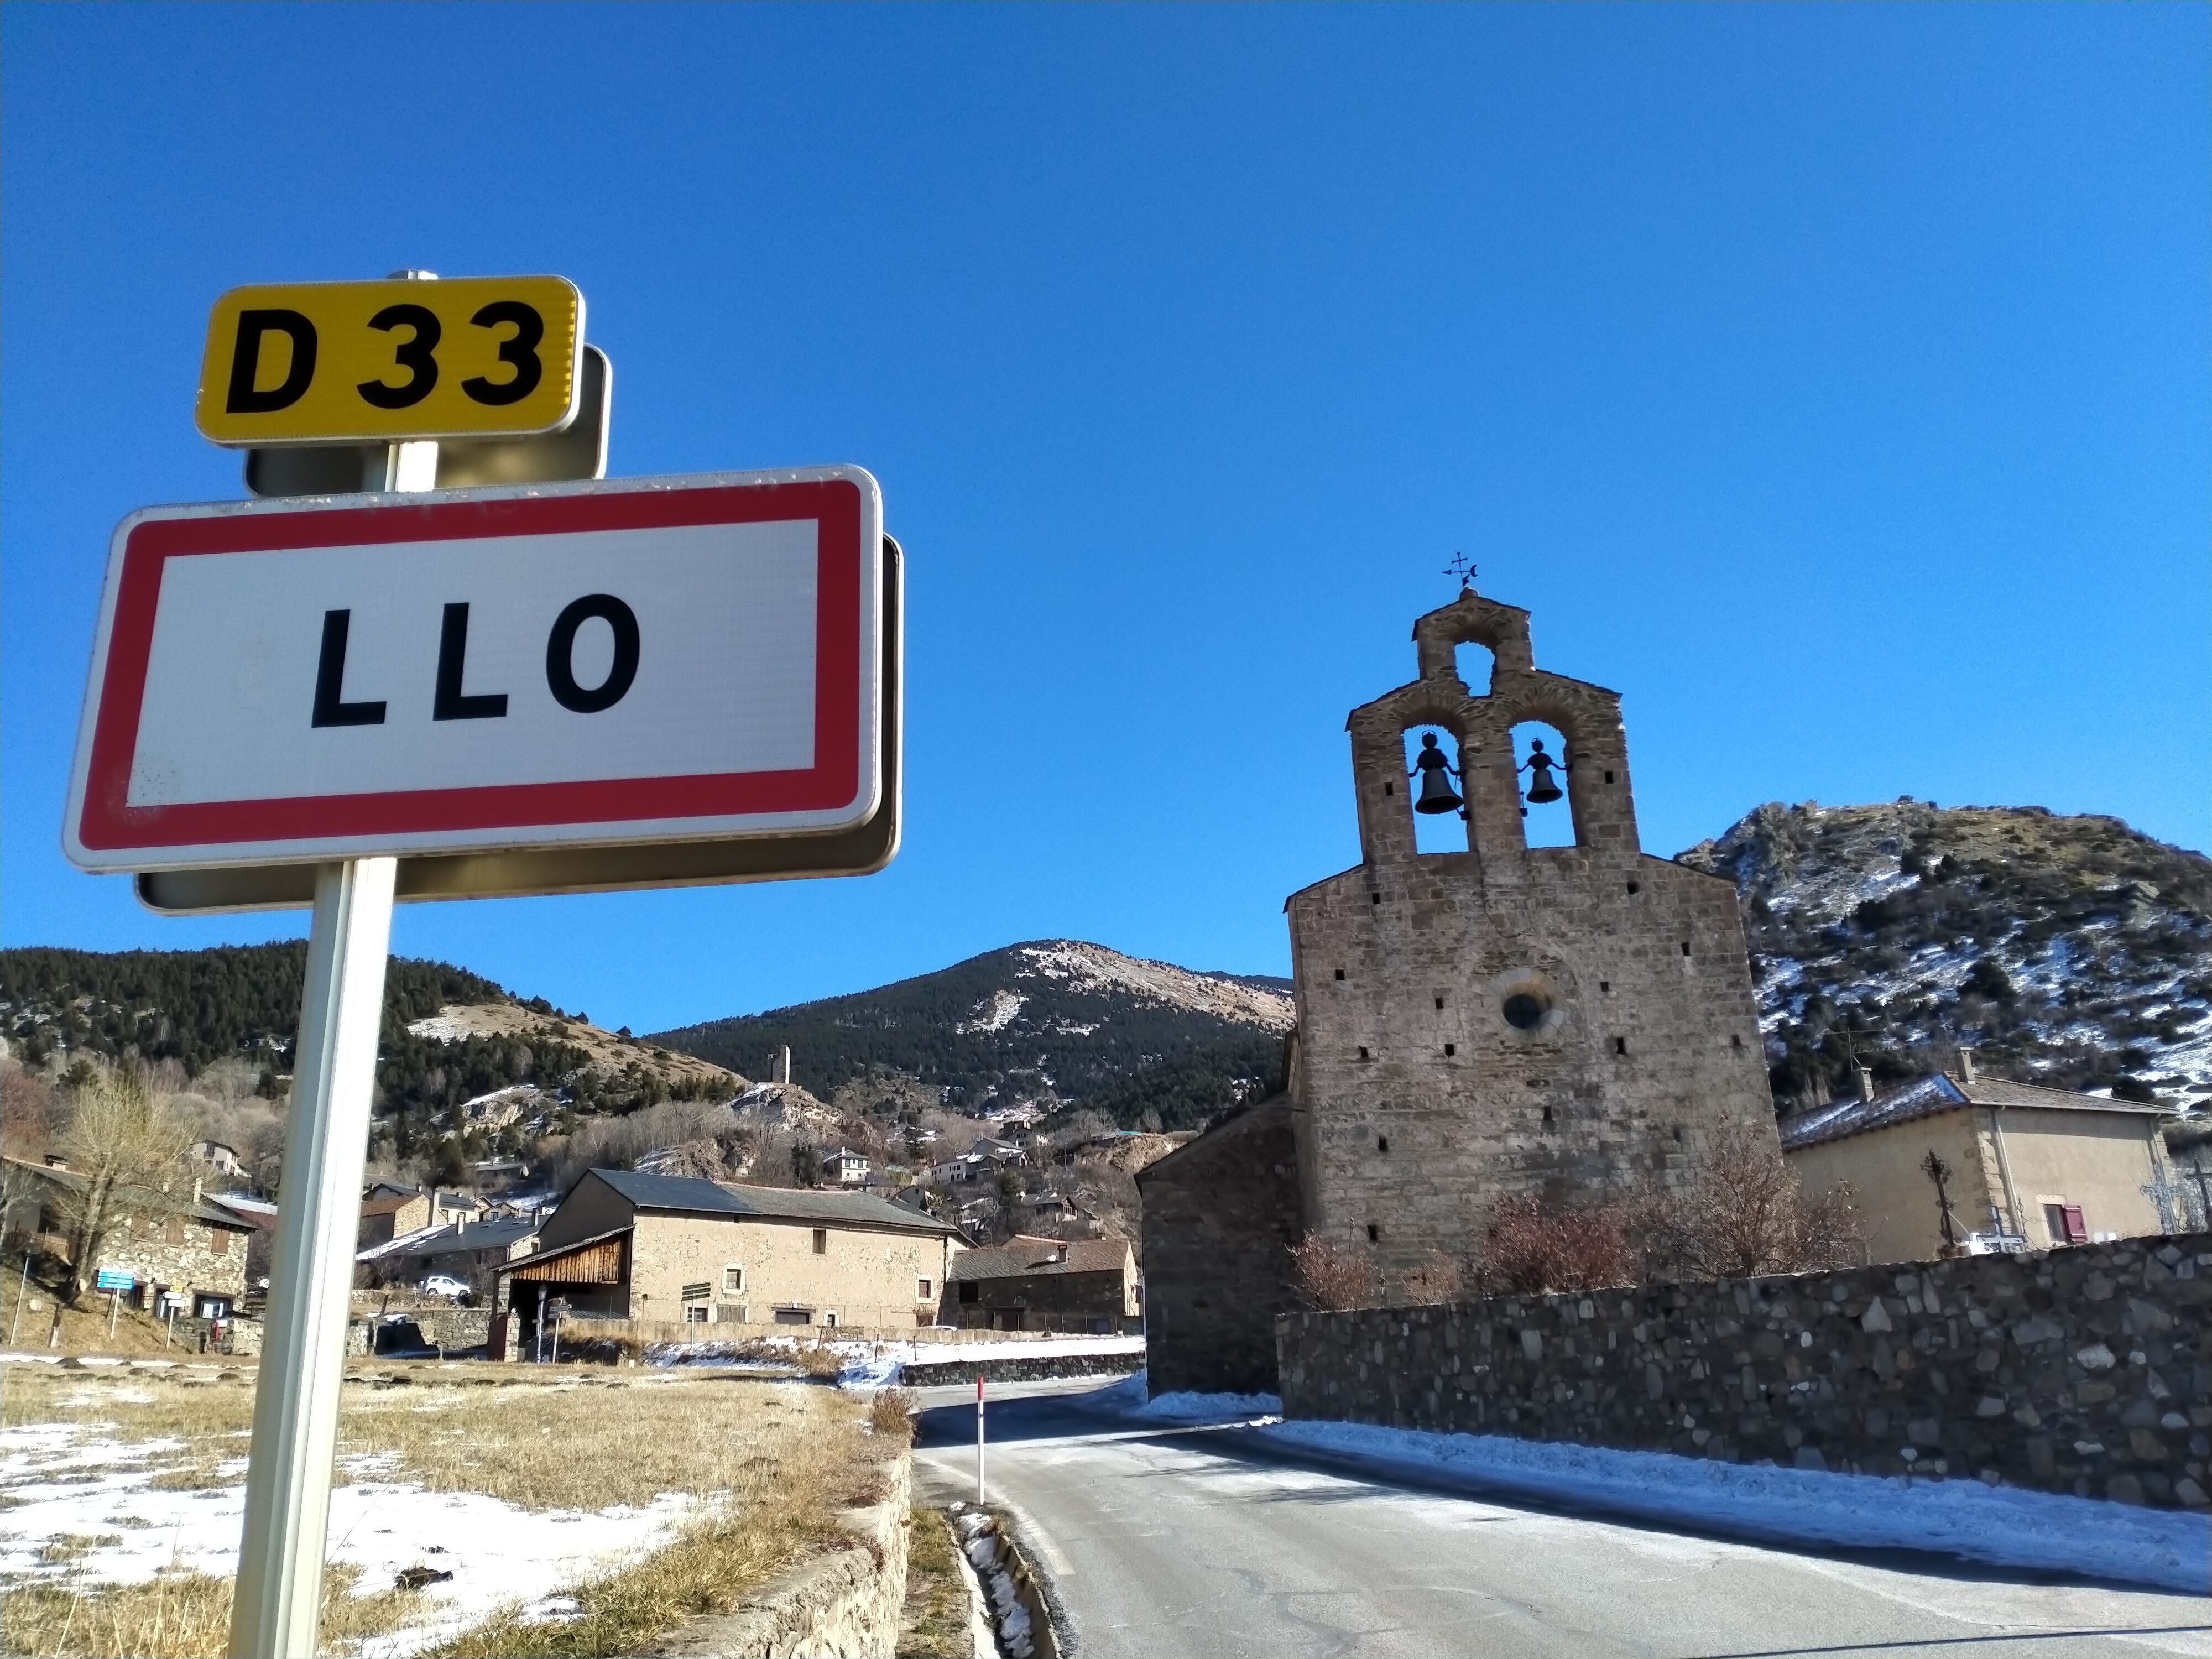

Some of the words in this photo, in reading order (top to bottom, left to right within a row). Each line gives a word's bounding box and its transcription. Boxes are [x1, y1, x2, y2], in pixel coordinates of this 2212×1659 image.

[226, 309, 317, 414] D
[357, 300, 544, 409] 33
[311, 594, 640, 728] LLO
